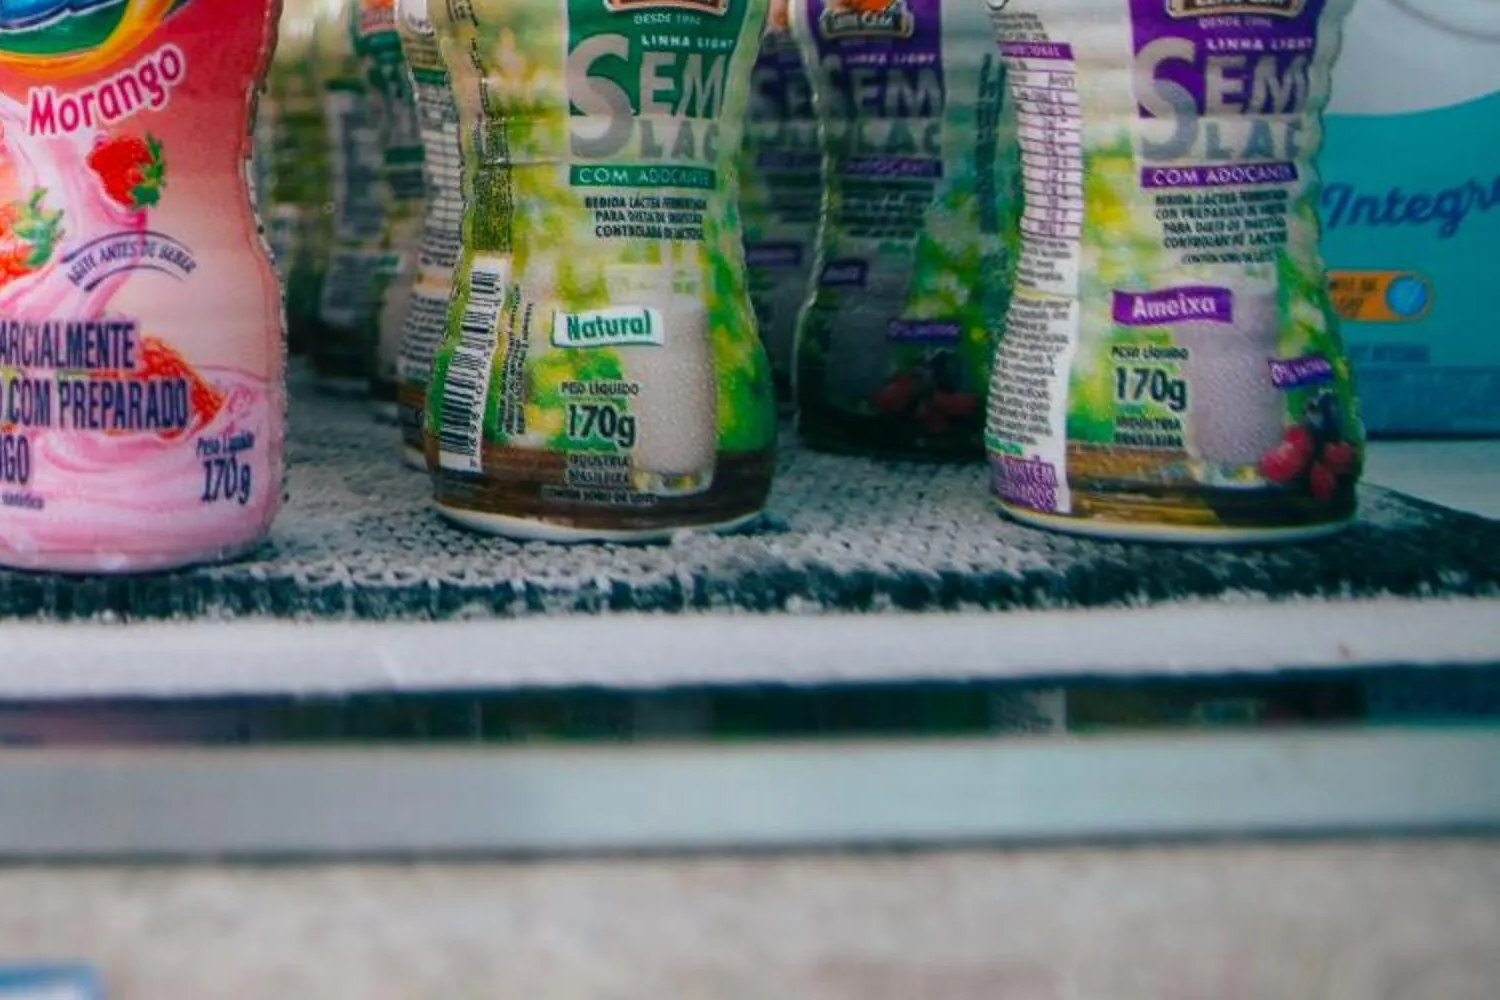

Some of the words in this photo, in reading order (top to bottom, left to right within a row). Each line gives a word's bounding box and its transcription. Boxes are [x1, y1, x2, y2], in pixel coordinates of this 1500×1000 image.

[642, 35, 691, 47] LINHA
[696, 38, 735, 50] LIGHT
[1206, 37, 1264, 50] LINHA
[29, 47, 184, 135] Morango
[579, 168, 629, 183] COM
[1153, 169, 1199, 185] COM
[595, 210, 626, 222] PARA
[99, 241, 139, 263] ANTES
[1131, 292, 1217, 320] Ameixa
[566, 309, 653, 341] Natural
[8, 376, 52, 427] COM
[58, 377, 190, 430] PREPARADO
[1115, 366, 1188, 412] 170g
[568, 403, 636, 449] 170g
[202, 455, 252, 506] 170g
